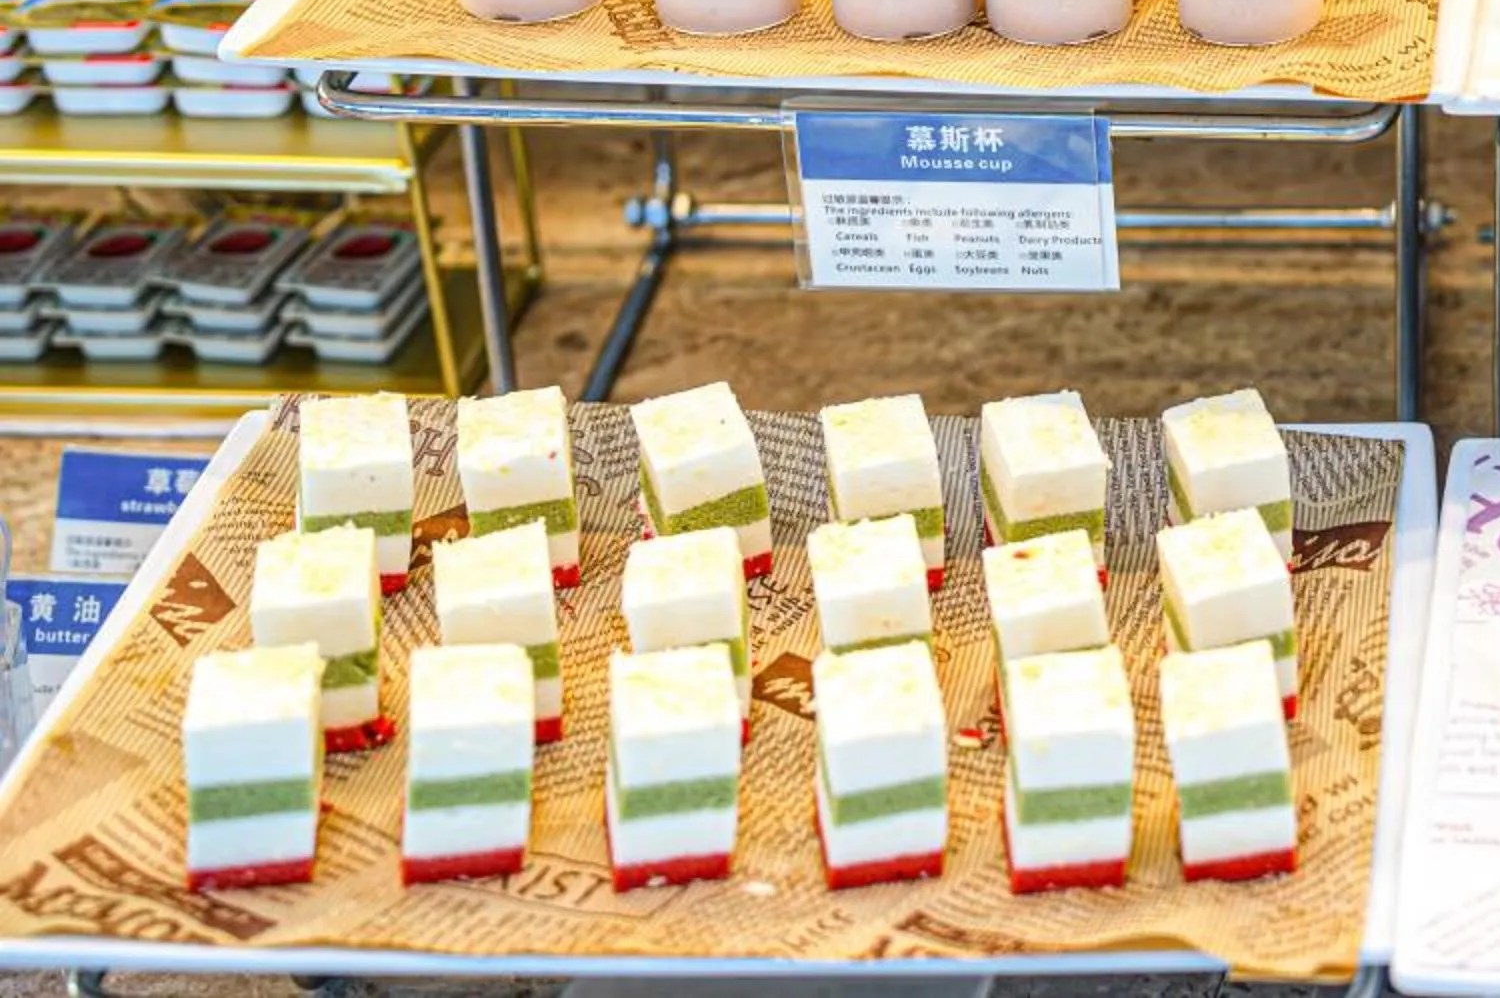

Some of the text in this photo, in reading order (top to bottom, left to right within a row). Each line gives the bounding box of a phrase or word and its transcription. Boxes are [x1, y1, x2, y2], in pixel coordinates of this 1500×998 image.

[905, 125, 1004, 153] 慕斯杯
[900, 155, 1013, 173] Mousse cup
[836, 231, 878, 241] Cereals
[954, 234, 1000, 244] Peanuts
[1052, 235, 1102, 245] Products
[909, 263, 937, 274] Eggs
[1021, 265, 1049, 275] Nuts
[120, 500, 180, 514] strawb
[29, 593, 101, 624] 黄油
[35, 628, 91, 644] butter
